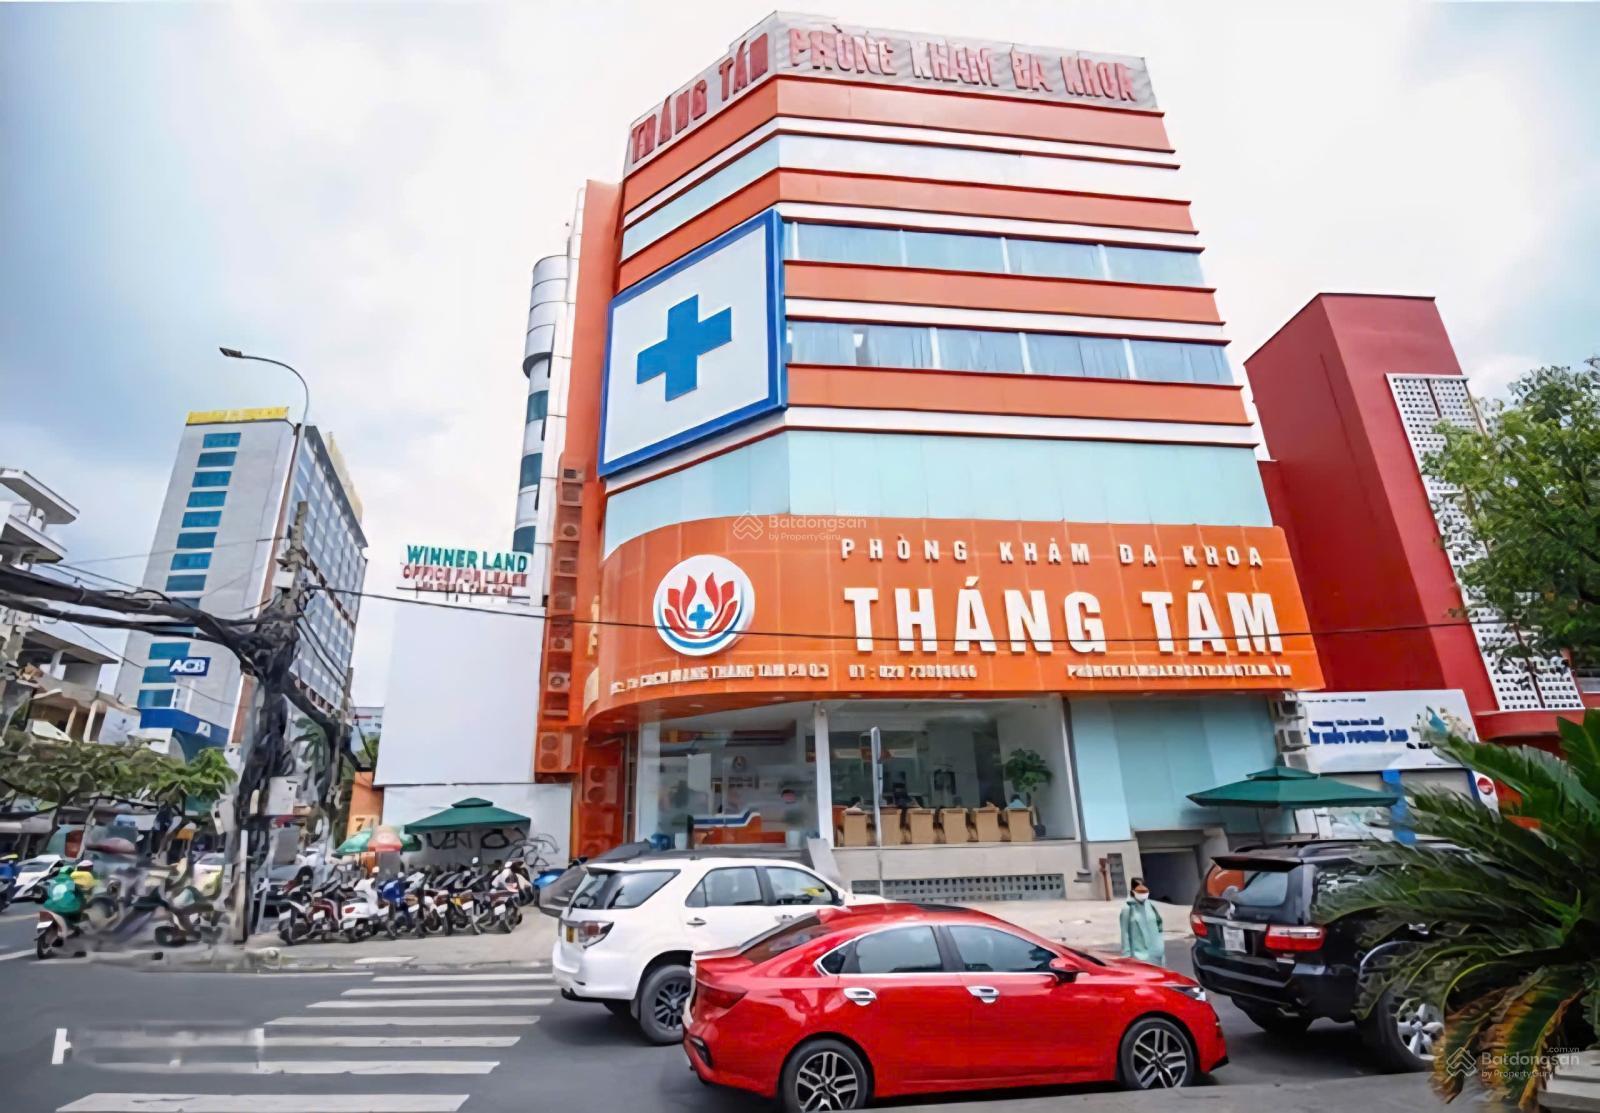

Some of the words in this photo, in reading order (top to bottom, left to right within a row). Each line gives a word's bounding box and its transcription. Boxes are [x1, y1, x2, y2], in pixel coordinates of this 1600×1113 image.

[407, 545, 478, 569] WINNER
[482, 551, 527, 573] LAND
[841, 534, 968, 562] PHÒNG
[1182, 545, 1263, 568] KHOA
[843, 576, 1107, 654] THÁNG
[1141, 580, 1284, 655] TÁM
[170, 659, 205, 673] ACB
